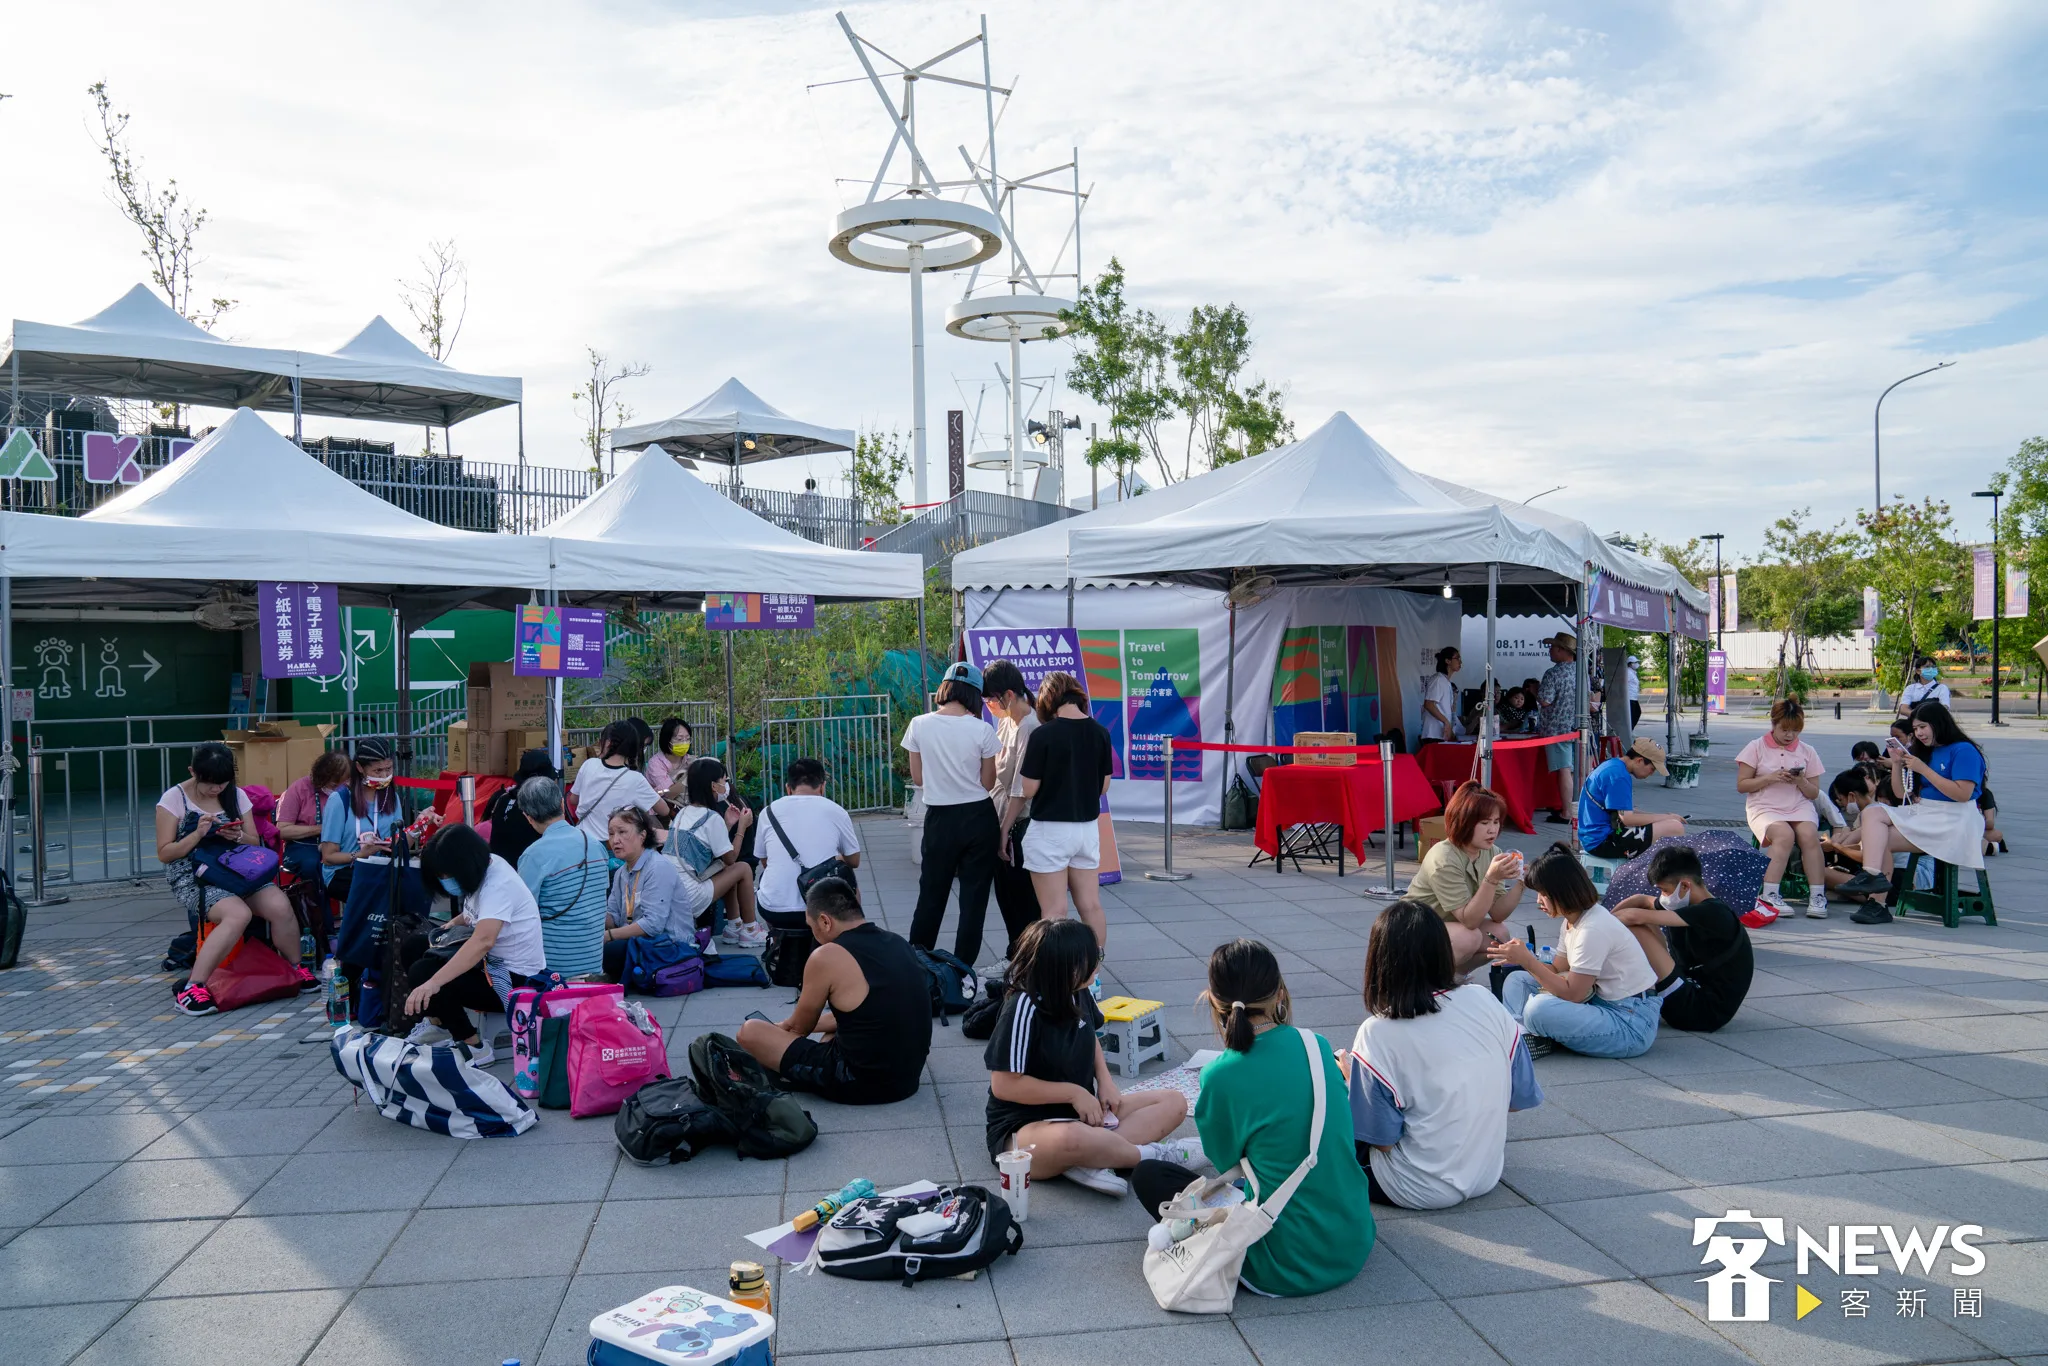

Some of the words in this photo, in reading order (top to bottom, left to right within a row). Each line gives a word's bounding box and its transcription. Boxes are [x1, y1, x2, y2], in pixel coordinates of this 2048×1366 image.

[275, 597, 293, 661] 紙本票券
[306, 596, 324, 660] 電子票券
[979, 634, 1073, 656] HAKKA
[1128, 642, 1166, 653] Travel
[1496, 639, 1525, 649] 08.11
[1048, 656, 1075, 667] EXPO
[1132, 656, 1144, 667] to
[1131, 670, 1190, 681] Tomorrow
